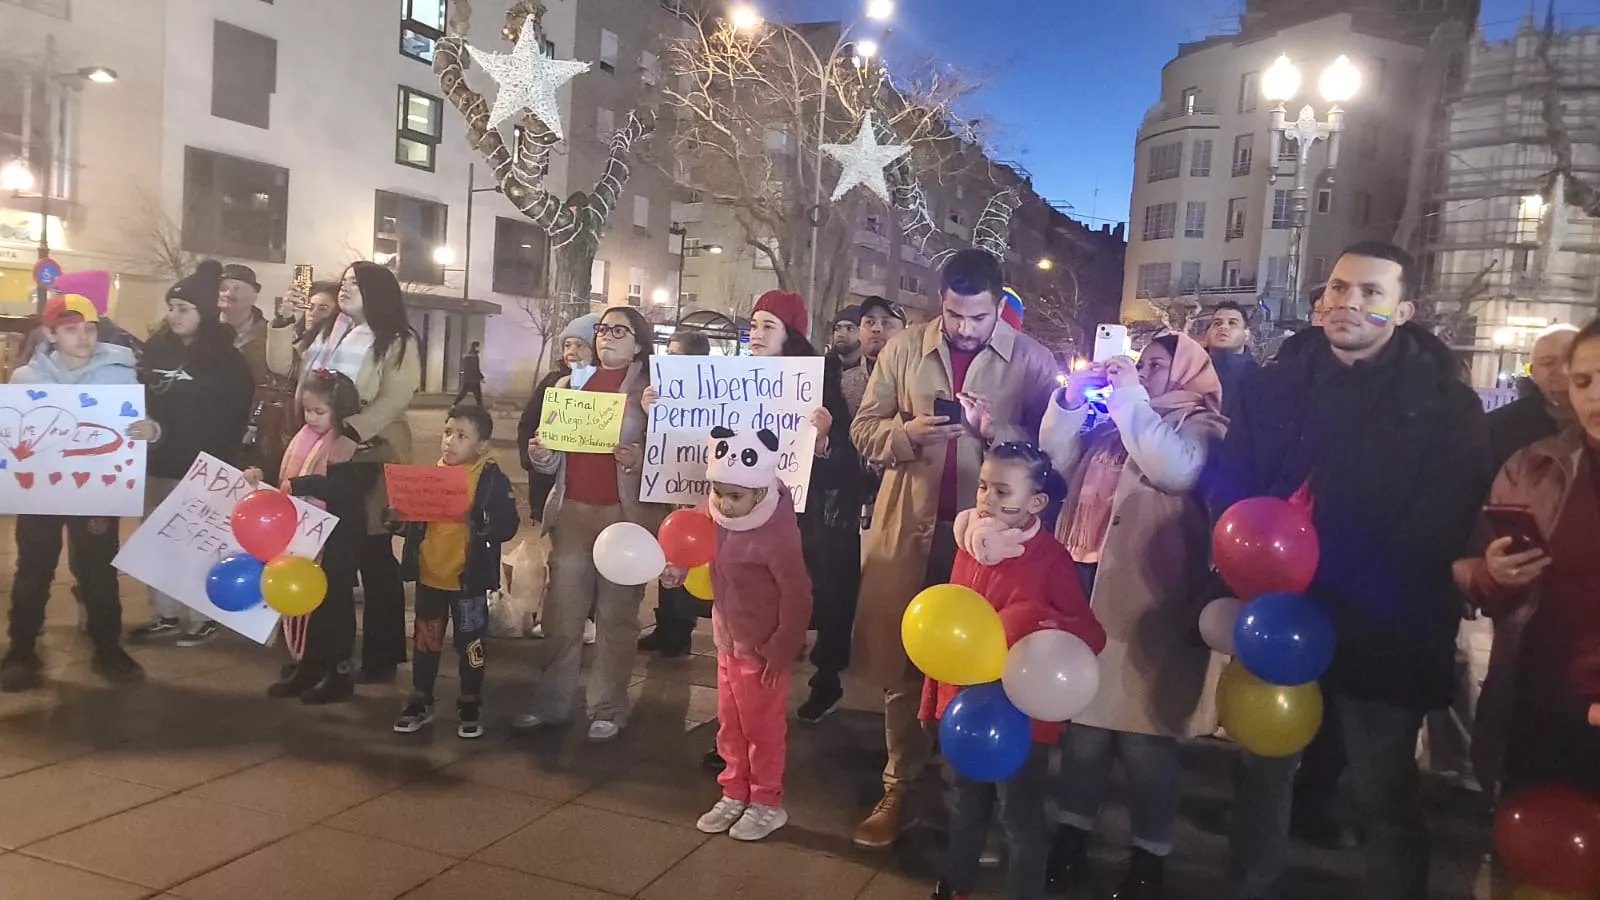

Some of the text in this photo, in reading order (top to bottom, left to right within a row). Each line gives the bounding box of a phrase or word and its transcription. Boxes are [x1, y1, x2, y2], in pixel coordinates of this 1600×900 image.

[655, 362, 685, 400] La
[792, 372, 812, 403] Te
[564, 397, 596, 412] Final
[751, 403, 807, 440] dejar
[647, 432, 667, 466] el
